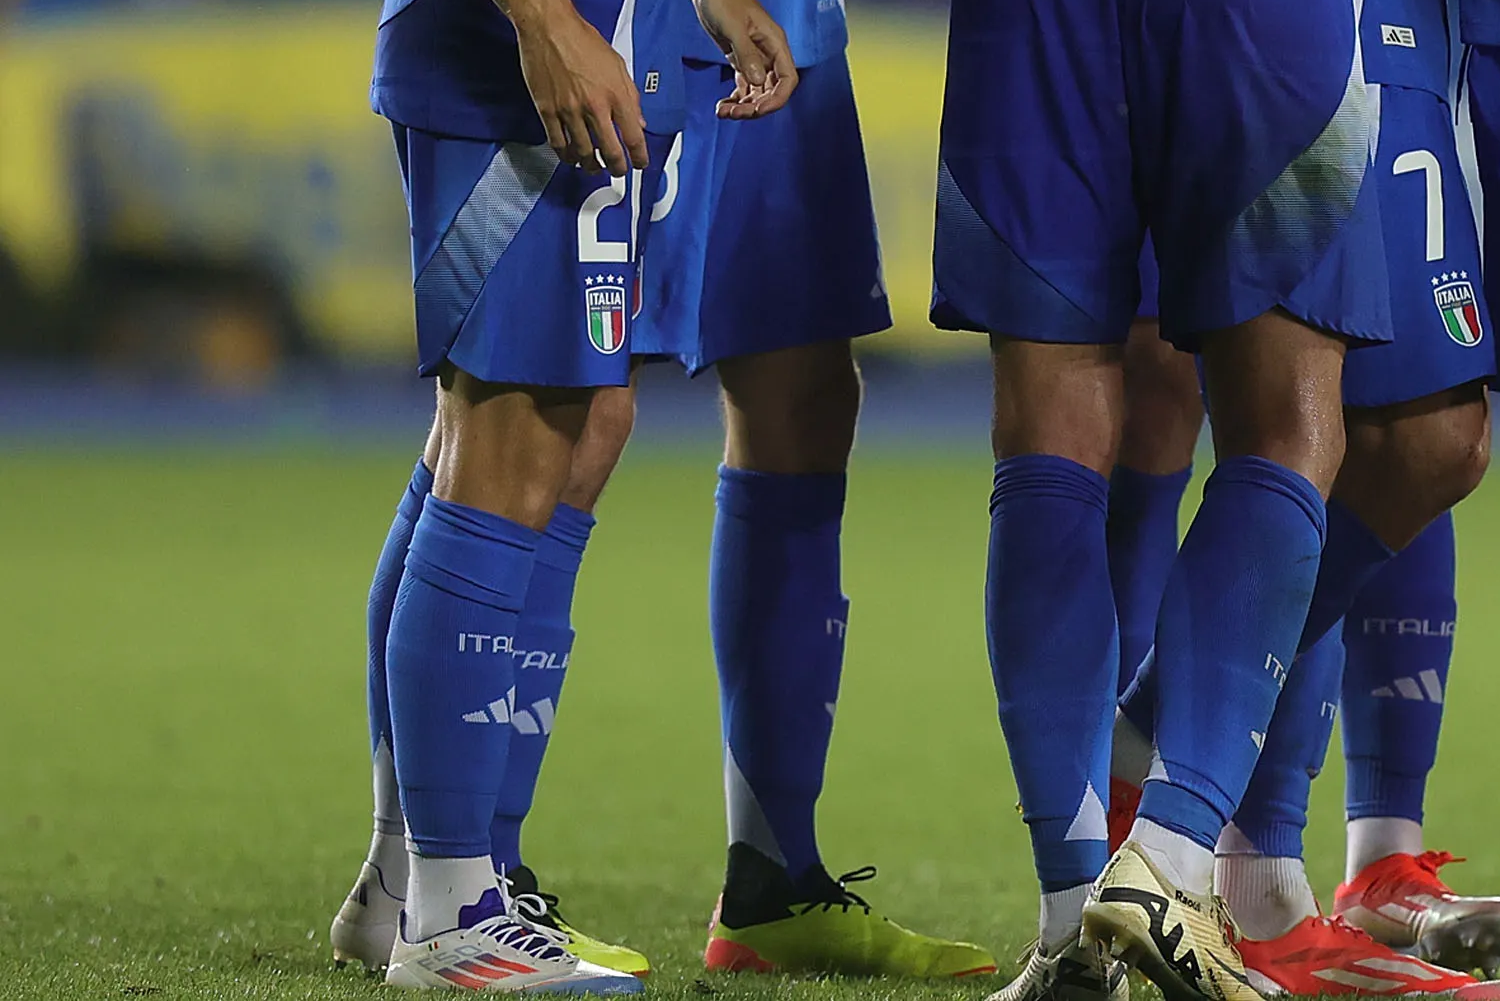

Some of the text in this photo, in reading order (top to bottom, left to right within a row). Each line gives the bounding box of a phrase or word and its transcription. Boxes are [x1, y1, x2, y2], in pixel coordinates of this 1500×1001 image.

[1393, 149, 1443, 262] 7
[590, 292, 622, 306] ITALIA
[1438, 286, 1471, 305] ITALIA
